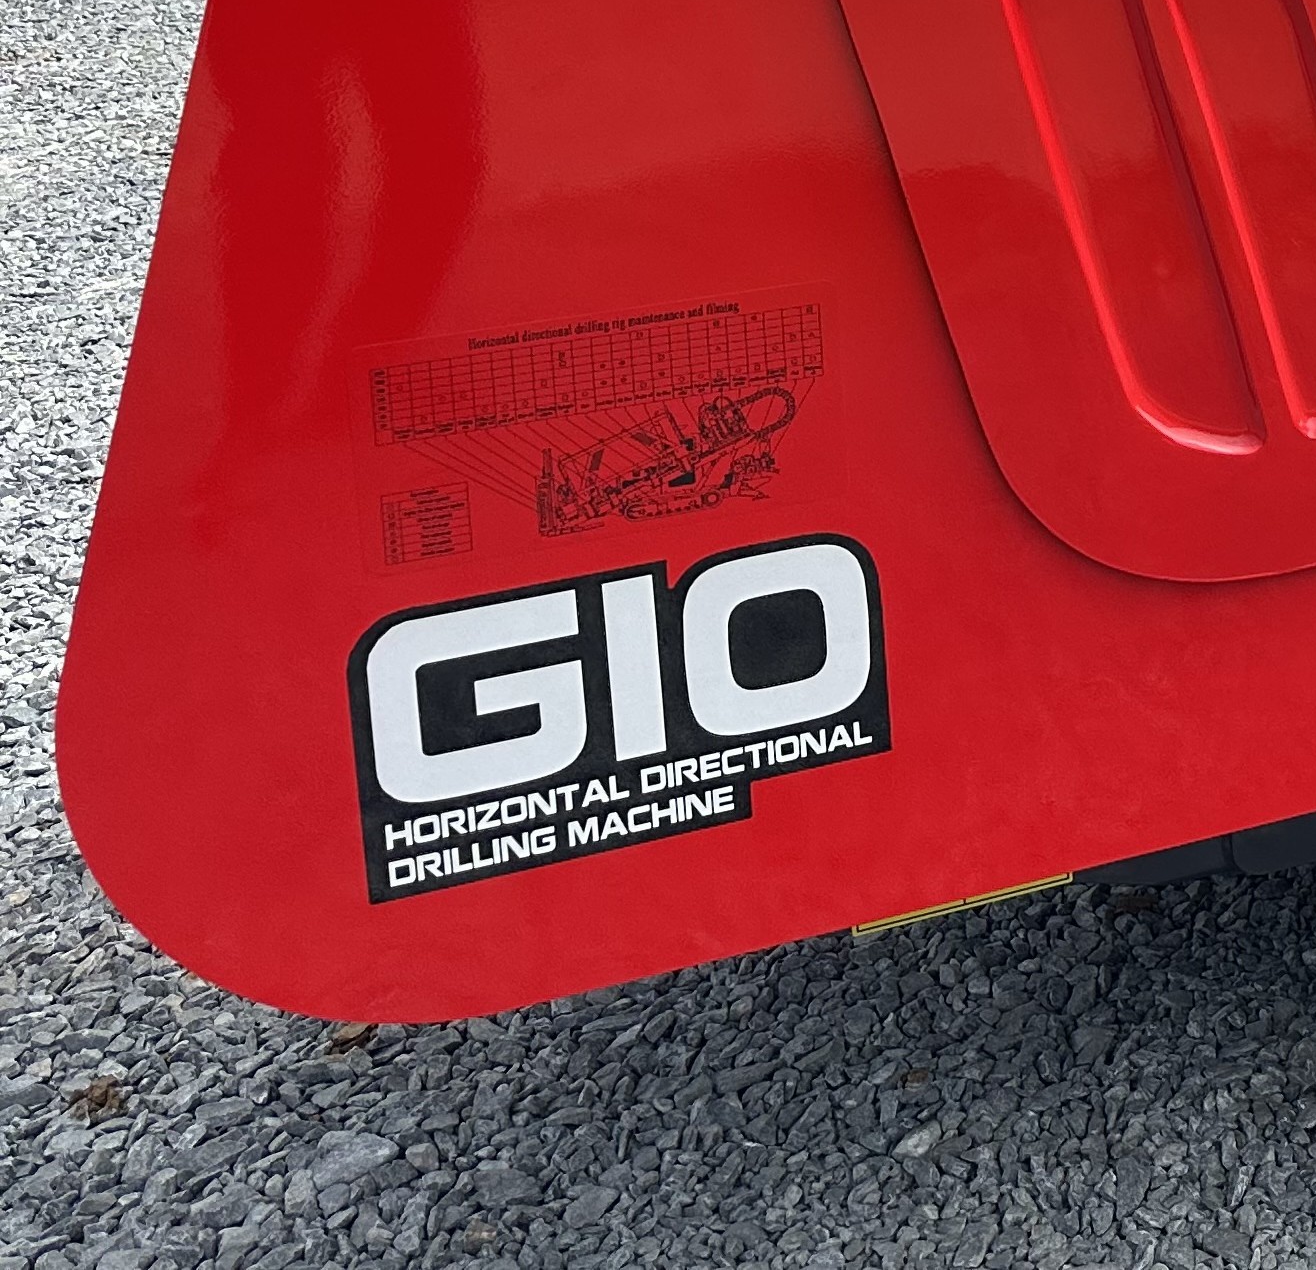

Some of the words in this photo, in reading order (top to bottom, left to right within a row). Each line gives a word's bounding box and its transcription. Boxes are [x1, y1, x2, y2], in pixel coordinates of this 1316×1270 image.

[468, 332, 519, 351] Horizontal
[521, 324, 573, 343] directional
[574, 316, 610, 335] drilling
[611, 315, 627, 331] rig
[687, 303, 704, 318] and
[383, 775, 630, 851] HORIZONTAL
[640, 723, 873, 793] DIRECTIONAL
[388, 825, 556, 888] DRILLING
[568, 785, 735, 847] MACHINE
